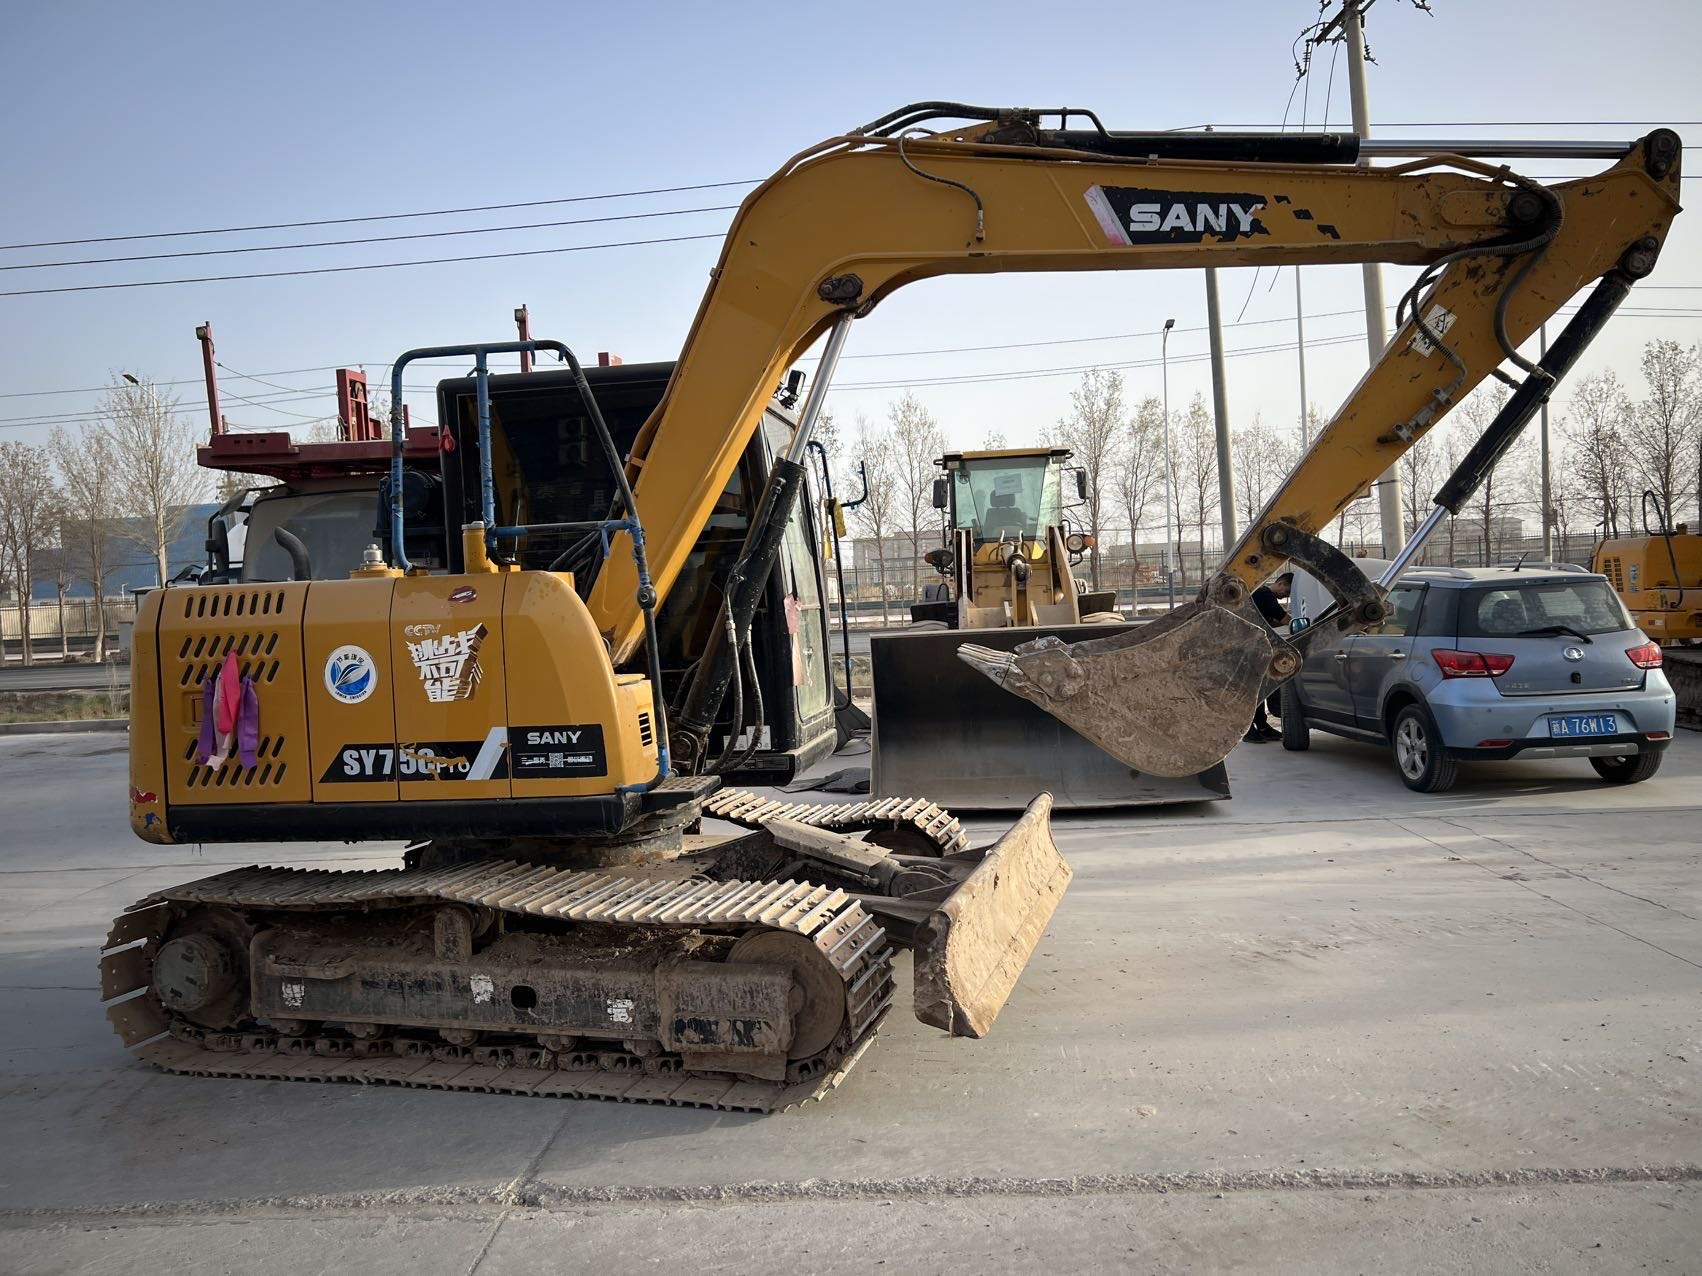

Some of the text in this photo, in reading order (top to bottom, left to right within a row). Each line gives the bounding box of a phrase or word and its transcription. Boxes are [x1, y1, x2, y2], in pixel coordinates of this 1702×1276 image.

[1129, 203, 1265, 232] SANY
[404, 624, 441, 637] CCTV
[405, 623, 484, 662] 挑战
[526, 731, 582, 745] SANY
